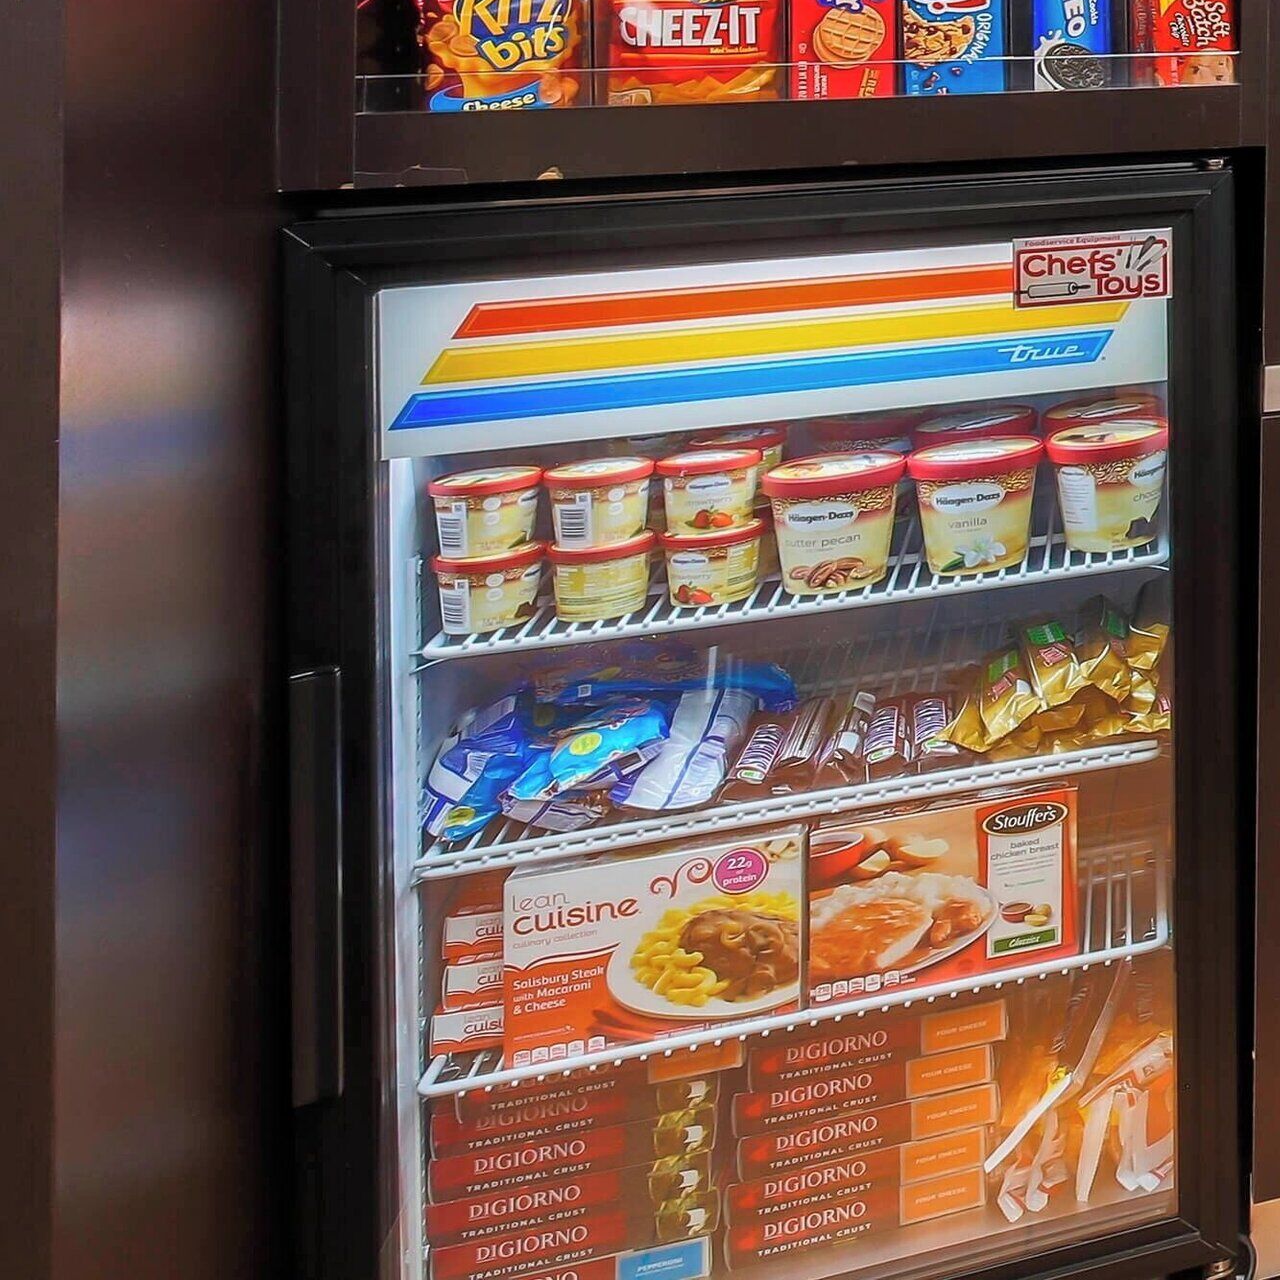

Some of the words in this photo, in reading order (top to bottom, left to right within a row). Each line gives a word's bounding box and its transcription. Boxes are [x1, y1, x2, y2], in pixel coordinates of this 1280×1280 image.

[618, 5, 761, 48] CHEEZ-IT
[1203, 0, 1231, 38] Soft
[481, 25, 566, 70] bits
[463, 93, 536, 111] Cheese
[1024, 238, 1075, 248] Foodservice
[1076, 234, 1121, 244] Equipment
[1023, 248, 1123, 278] Chefs'
[1089, 273, 1161, 298] Toys
[1003, 344, 1086, 363] true
[935, 491, 1001, 508] Häagen-Dazs
[787, 510, 855, 525] Häagen-Dazs
[947, 516, 988, 530] vanilla
[821, 533, 861, 549] pecan
[991, 806, 1059, 832] Stouffer's
[989, 846, 1028, 861] chicken
[1030, 842, 1061, 856] breast
[1009, 837, 1041, 850] baked
[726, 854, 753, 870] 22g
[722, 872, 758, 887] protein
[512, 891, 569, 914] lean
[512, 898, 640, 937] cuisine
[512, 937, 552, 951] culinary
[553, 928, 598, 943] collection
[513, 972, 570, 993] Salisbury
[571, 964, 605, 982] Steak
[513, 993, 535, 1004] with
[536, 980, 592, 1000] Macaroni
[513, 1004, 522, 1015] &
[524, 997, 568, 1014] Cheese
[785, 1030, 889, 1065] DIGIORNO
[779, 1058, 857, 1081] TRADITIONAL
[858, 1052, 893, 1066] CRUST
[491, 1089, 574, 1111] TRADITIONAL
[577, 1080, 617, 1094] CRUST
[770, 1074, 873, 1109] DIGIORNO
[764, 1102, 842, 1125] TRADITIONAL
[843, 1095, 879, 1109] CRUST
[468, 1127, 552, 1150] TRADITIONAL
[555, 1118, 594, 1132] CRUST
[775, 1116, 878, 1152] DIGIORNO
[473, 1140, 587, 1174] DIGIORNO
[769, 1145, 847, 1170] TRADITIONAL
[848, 1138, 884, 1152] CRUST
[465, 1170, 549, 1193] TRADITIONAL
[553, 1162, 592, 1177] CRUST
[764, 1161, 867, 1199] DIGIORNO
[468, 1185, 582, 1222] DIGIORNO
[757, 1192, 833, 1216] TRADITIONAL
[836, 1182, 872, 1198] CRUST
[461, 1216, 544, 1240] TRADITIONAL
[548, 1207, 587, 1221] CRUST
[763, 1202, 867, 1240] DIGIORNO
[475, 1225, 589, 1264] DIGIORNO
[757, 1233, 834, 1258] TRADITIONAL
[836, 1223, 872, 1238] CRUST
[468, 1259, 552, 1280] TRADITIONAL
[554, 1248, 594, 1263] CRUST
